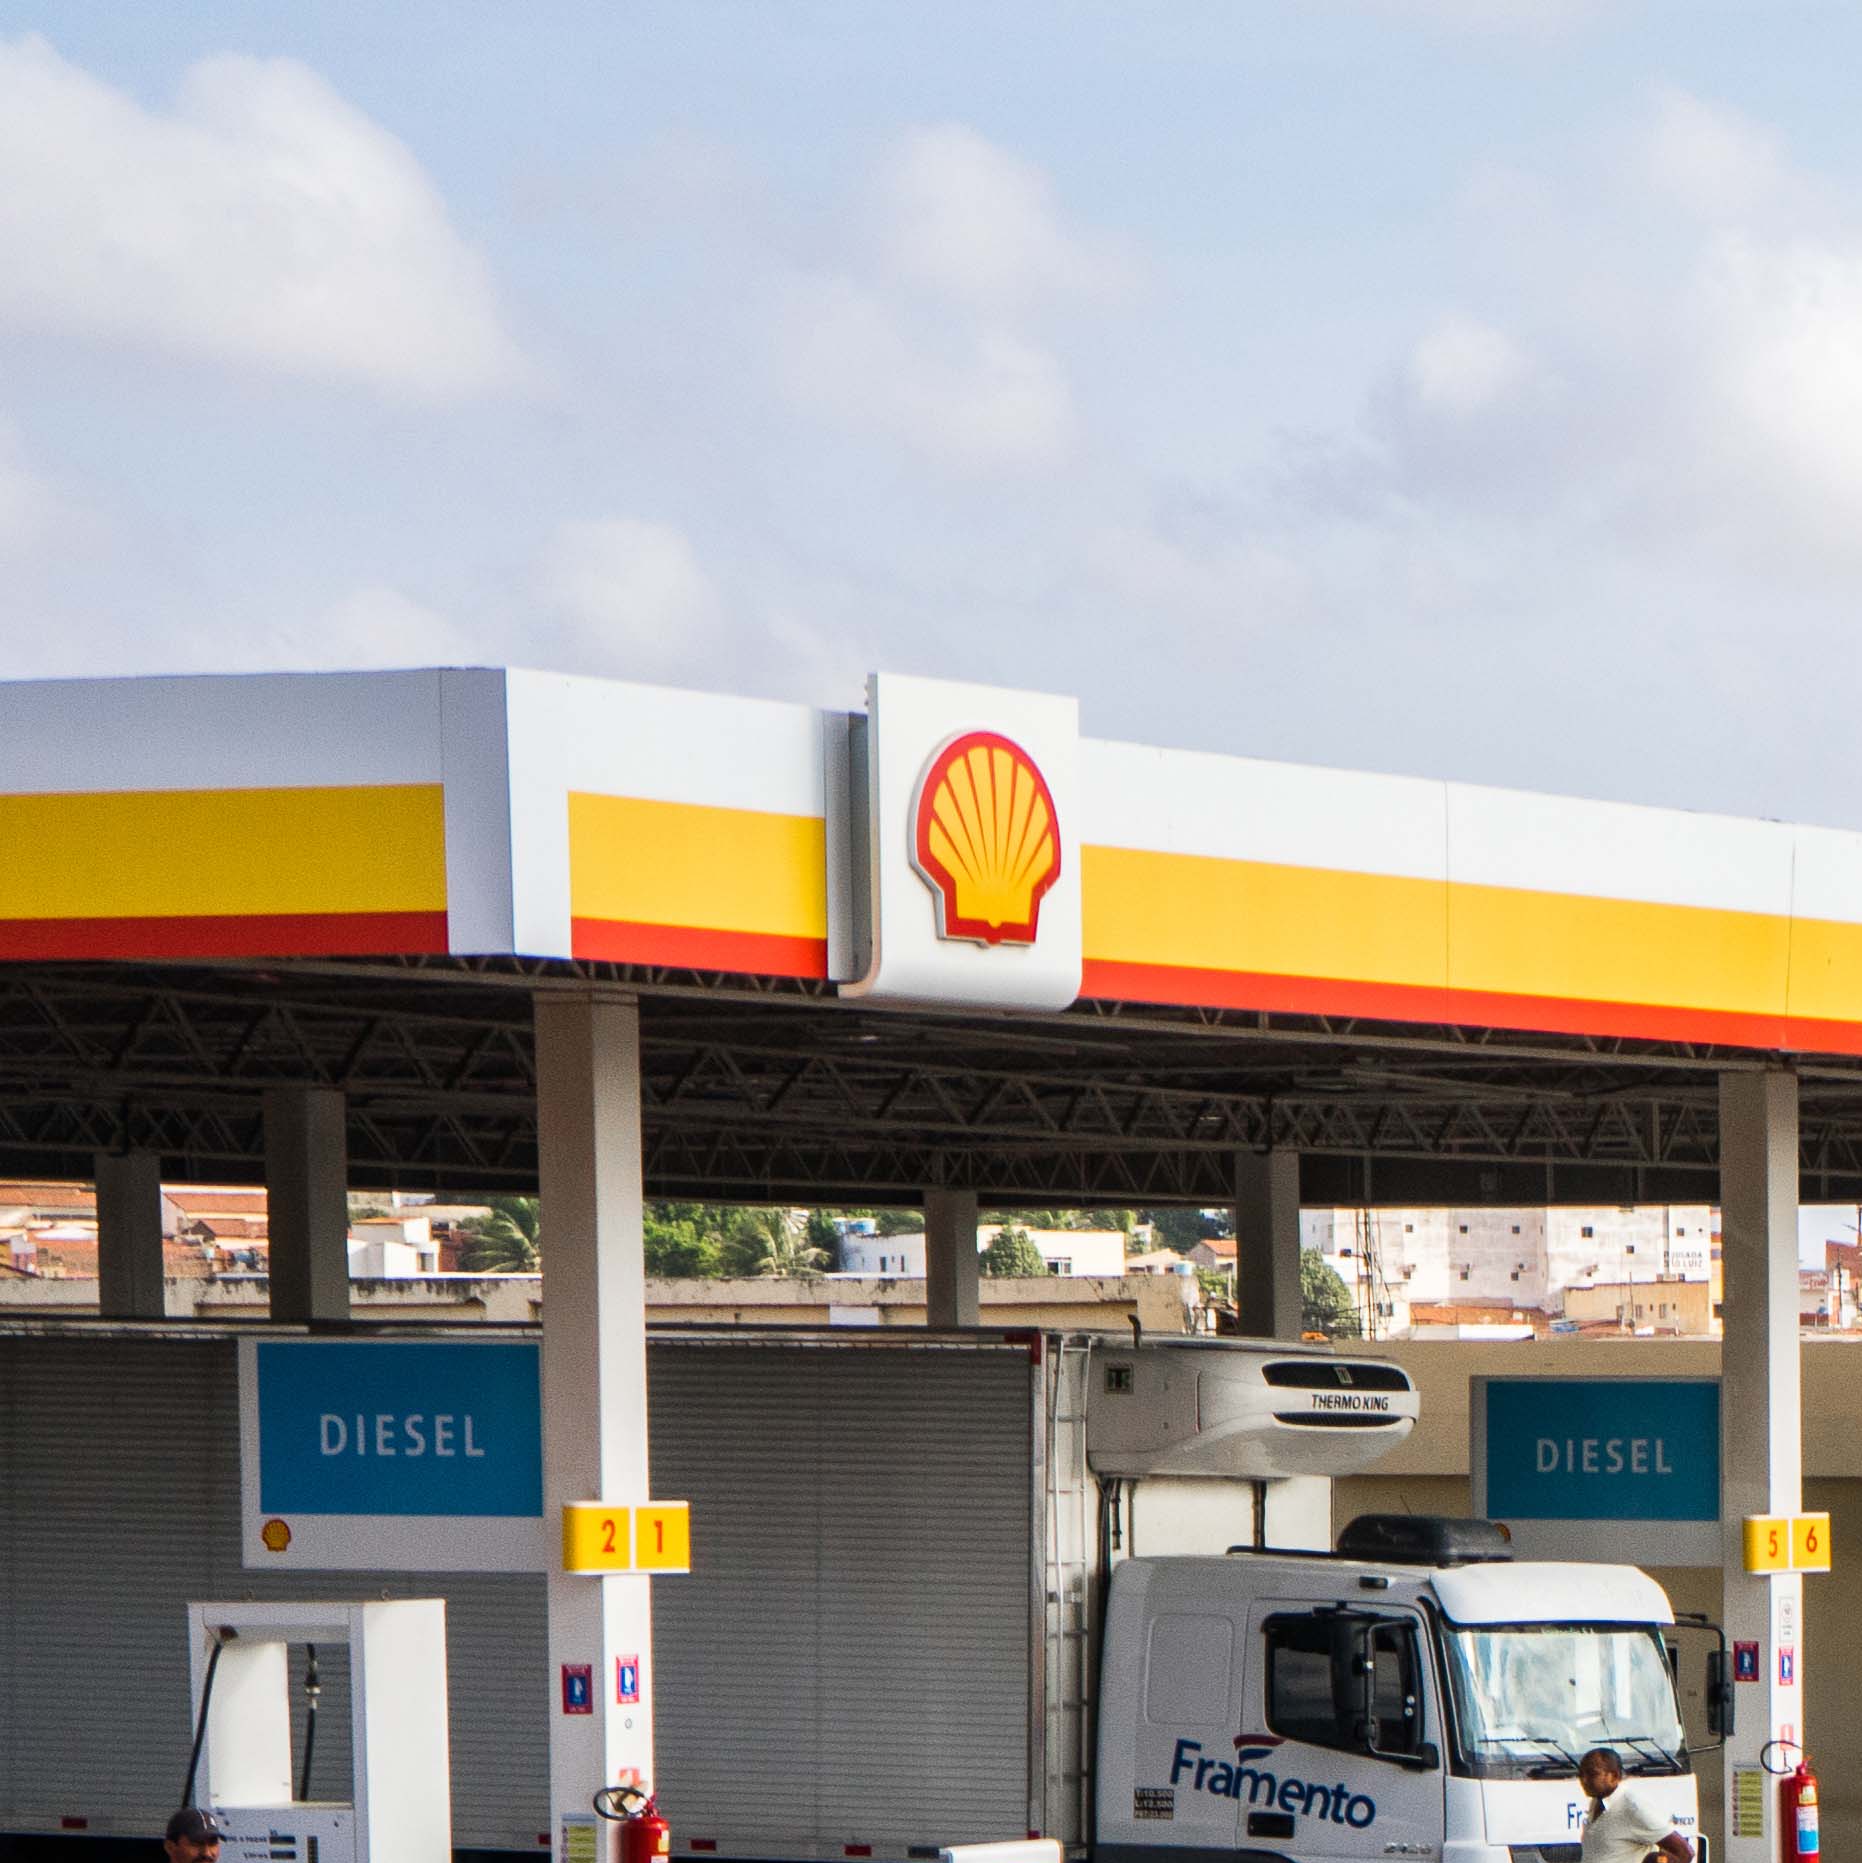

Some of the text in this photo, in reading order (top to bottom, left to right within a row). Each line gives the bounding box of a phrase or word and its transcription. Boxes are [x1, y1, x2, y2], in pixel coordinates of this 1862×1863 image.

[1311, 1394, 1389, 1411] THERMO KING
[319, 1413, 486, 1457] DIESEL
[1536, 1438, 1673, 1473] DIESEL
[601, 1519, 664, 1554] 2 1
[1768, 1526, 1818, 1558] 5 6
[1169, 1738, 1377, 1828] Framento
